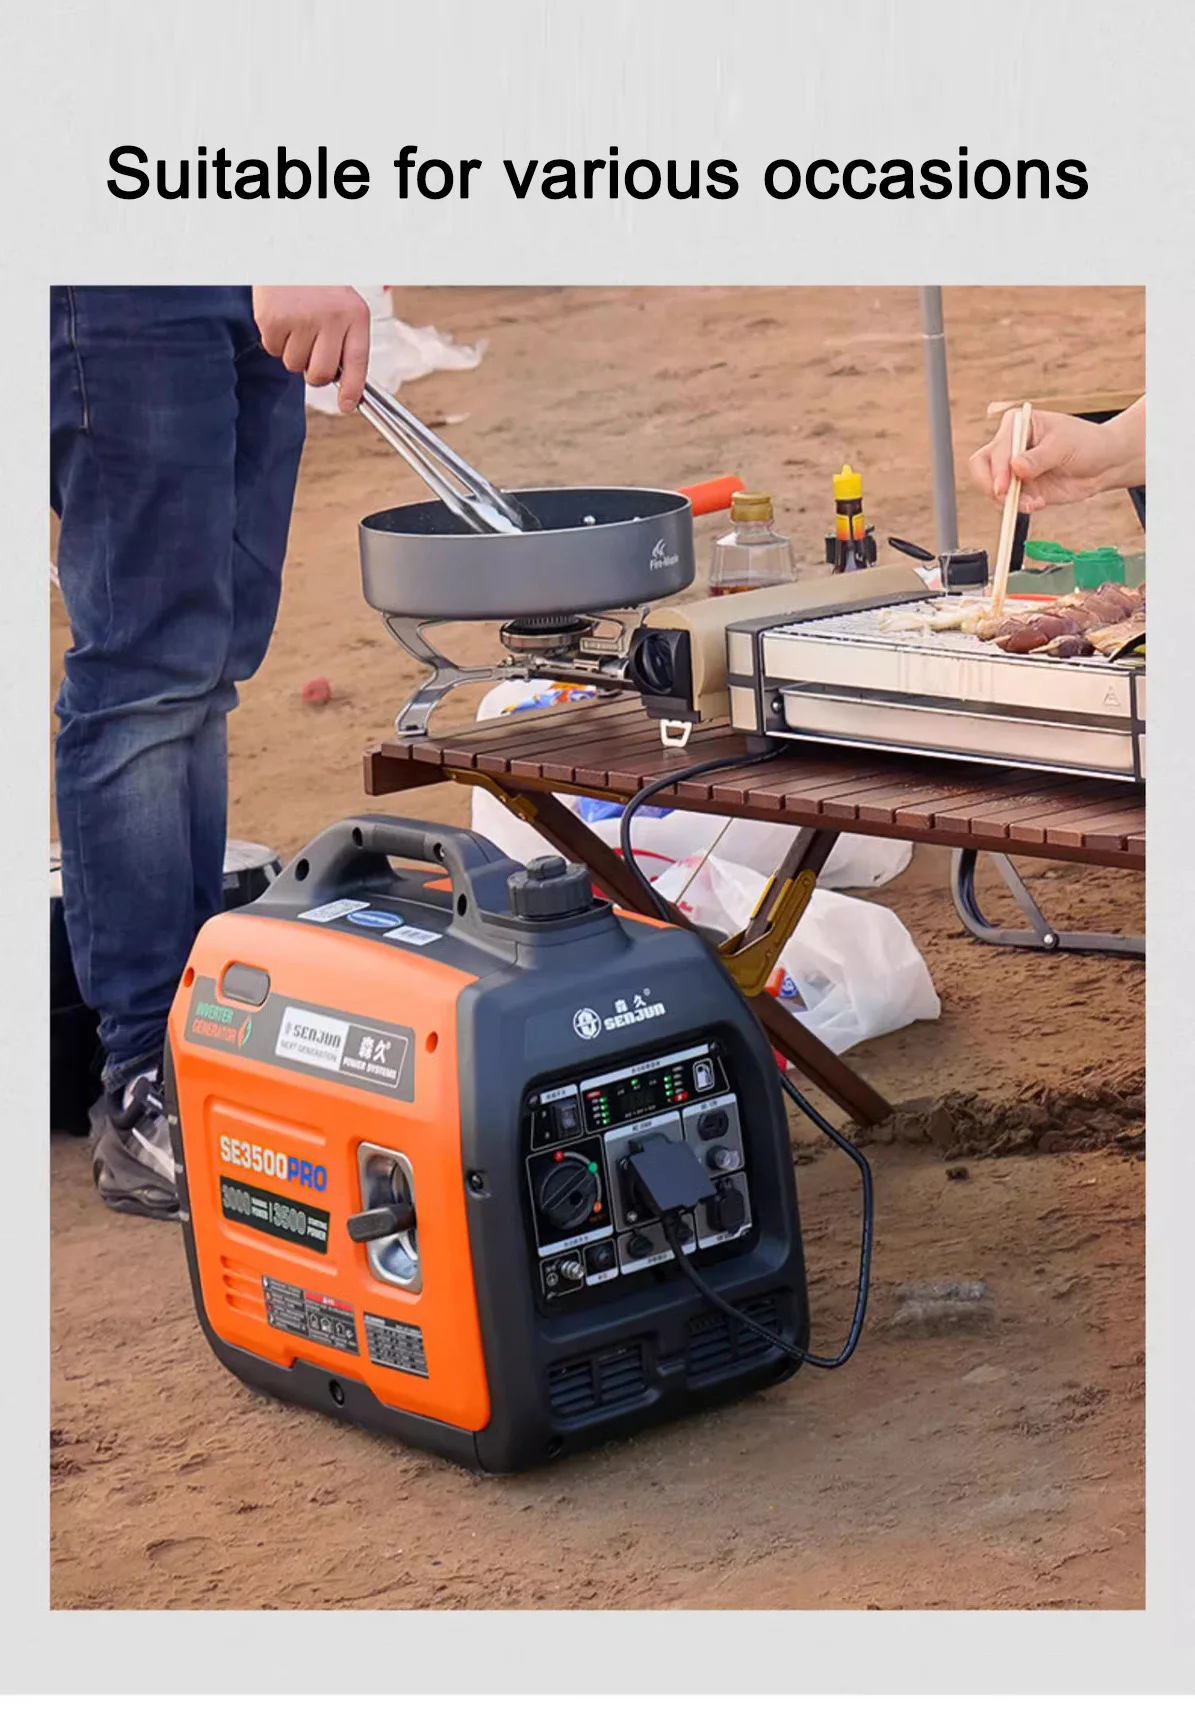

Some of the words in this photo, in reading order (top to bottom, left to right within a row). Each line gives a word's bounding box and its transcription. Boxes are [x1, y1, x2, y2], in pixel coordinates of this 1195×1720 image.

[603, 1002, 666, 1031] SENJUN
[293, 1024, 343, 1049] SENJUN
[219, 1135, 328, 1193] SE3500PRO
